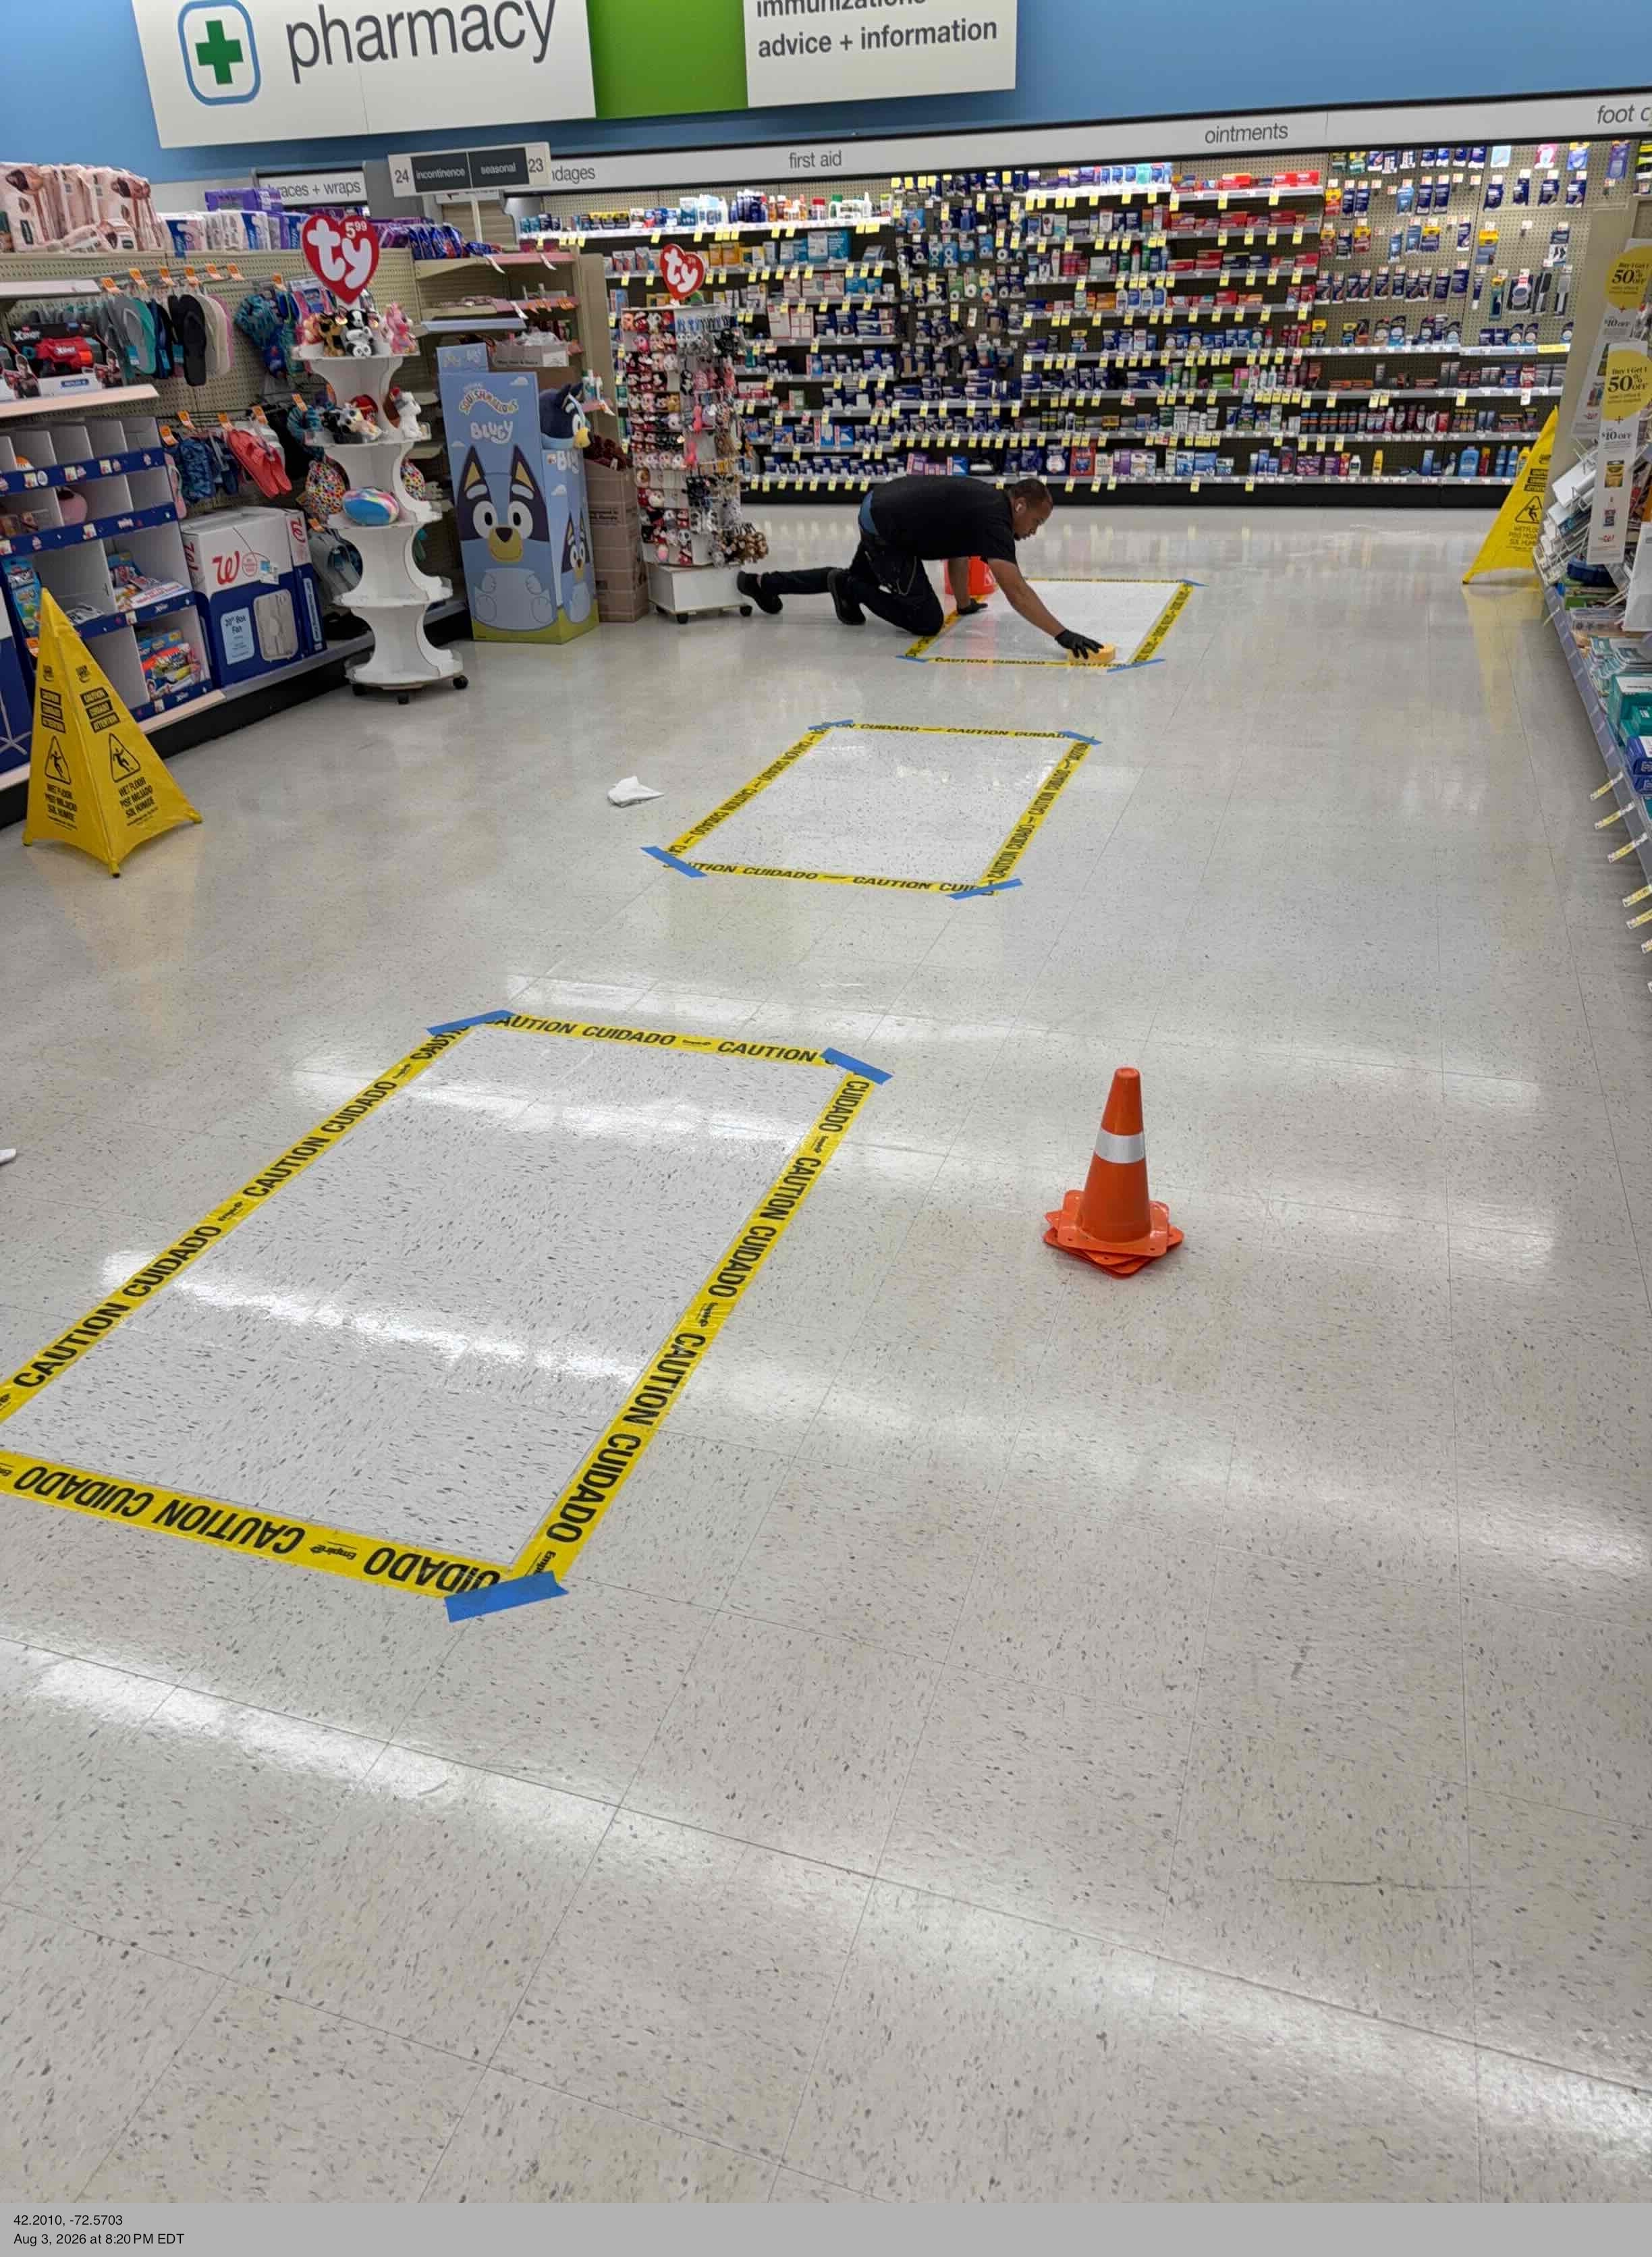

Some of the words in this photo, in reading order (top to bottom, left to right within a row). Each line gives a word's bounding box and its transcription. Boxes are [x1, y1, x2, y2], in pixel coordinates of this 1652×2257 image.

[286, 0, 555, 84] pharmacy
[759, 33, 831, 57] advice
[840, 35, 853, 51] +
[861, 19, 997, 49] information
[1205, 123, 1288, 144] ointments
[1597, 104, 1634, 124] foot
[395, 169, 409, 184] 24
[416, 166, 466, 180] incontinence
[480, 163, 516, 175] seasonal
[528, 157, 544, 173] 23
[789, 152, 815, 168] first
[820, 150, 842, 167] aid
[272, 183, 309, 198] aces
[324, 179, 361, 196] wraps
[307, 219, 373, 290] ty
[664, 248, 698, 293] ty
[1612, 269, 1634, 284] 50
[1607, 375, 1633, 392] 50
[212, 551, 240, 585] W
[860, 724, 919, 732] CUIDADO
[743, 866, 819, 880] CUIDADO
[853, 876, 932, 890] CAUTION
[987, 851, 1020, 879] CAUTION
[485, 1015, 577, 1035] AUTION
[582, 1025, 676, 1045] CUIDADO
[717, 1041, 819, 1062] CAUTION
[819, 1080, 870, 1133] CUIDADO
[759, 1157, 822, 1222] CAUTION
[13, 1302, 131, 1388] CAUTION
[122, 1224, 223, 1298] CUIDADO
[242, 1136, 331, 1197] CAUTION
[321, 1081, 397, 1133] CUIDADO
[707, 1225, 777, 1299] CUIDADO
[622, 1332, 707, 1426] CAUTION
[13, 1466, 155, 1517] CUIDADO
[546, 1433, 642, 1543] CUIDADO
[152, 1497, 307, 1554] CAUTION
[363, 1546, 501, 1594] UIDADO
